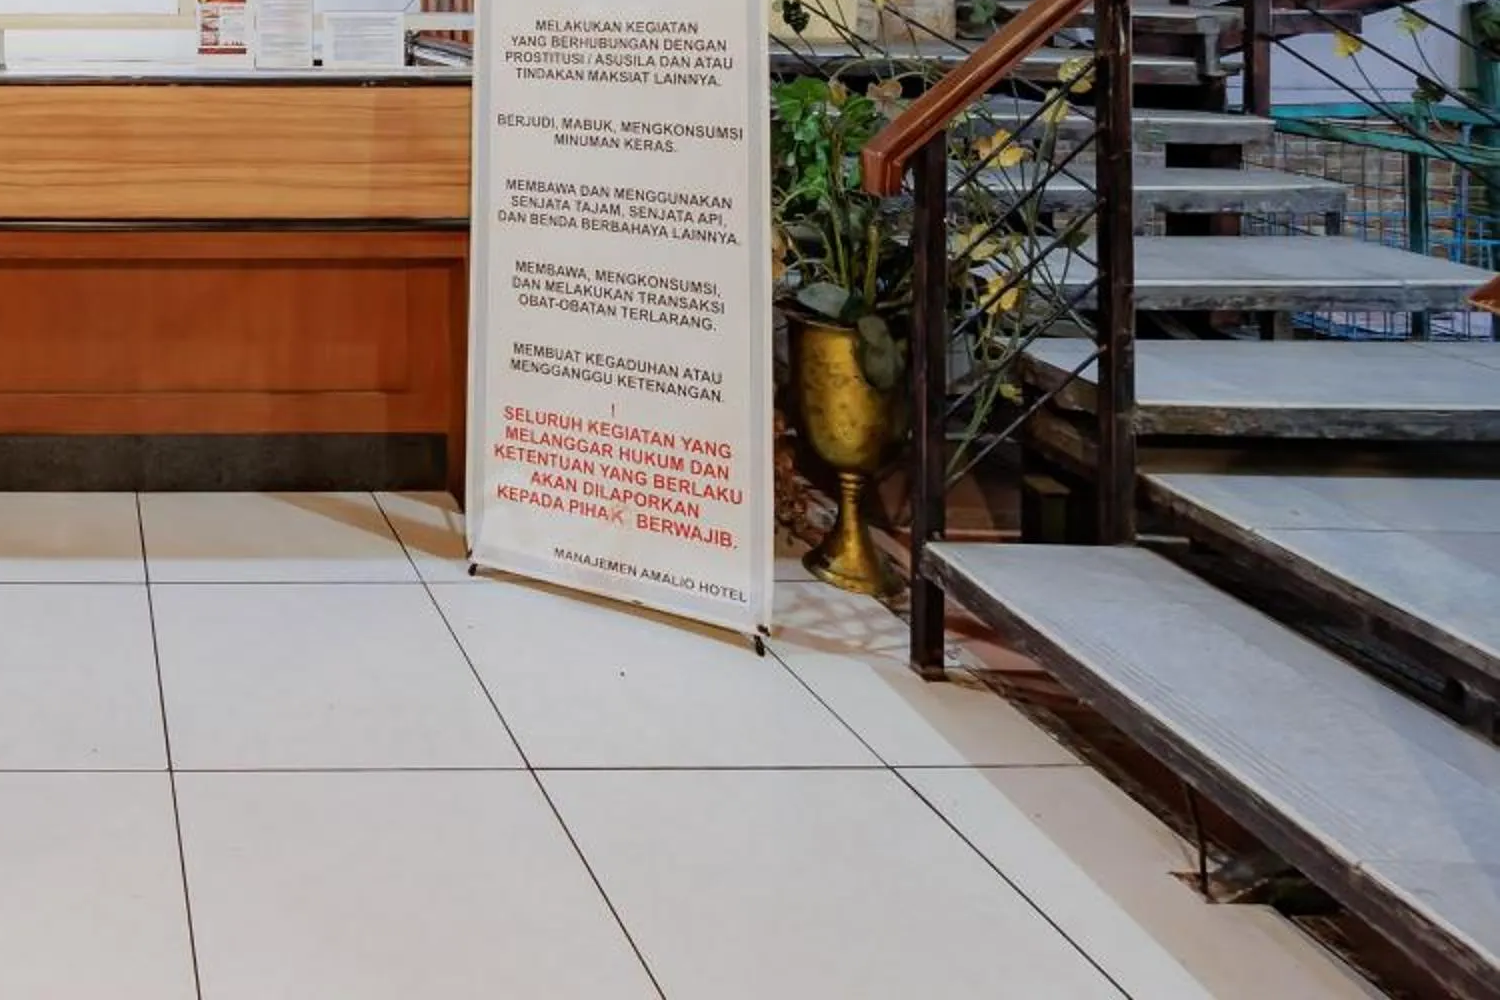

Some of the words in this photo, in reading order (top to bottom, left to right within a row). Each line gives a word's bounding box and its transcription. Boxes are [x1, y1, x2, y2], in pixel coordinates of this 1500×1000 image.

[535, 19, 623, 34] MELAKUKAN
[625, 21, 699, 35] KEGIATAN
[511, 35, 547, 49] YANG
[551, 36, 659, 52] BERHUBUNGAN
[663, 39, 727, 53] DENGAN
[505, 50, 585, 66] PROSTITUSI
[594, 53, 657, 69] ASUSILA
[659, 55, 691, 70] DAN
[693, 56, 734, 71] ATAU
[515, 67, 585, 81] TINDAKAN
[587, 69, 651, 84] MAKSIAT
[554, 134, 620, 148] MINUMAN
[620, 121, 743, 140] MENGKONSUMSI
[506, 179, 577, 196] MEMBAWA
[580, 184, 610, 198] DAN
[614, 188, 732, 209] MENGGUNAKAN
[498, 210, 528, 224] DAN
[530, 213, 579, 229] BENDA
[582, 218, 669, 238] BERBAHAYA
[510, 196, 571, 211] SENJATA
[629, 206, 694, 224] SENJATA
[512, 276, 541, 291] DAN
[543, 280, 634, 302] MELAKUKAN
[636, 291, 724, 314] TRANSAKSI
[518, 293, 617, 316] OBAT-OBATAN
[510, 358, 613, 385] MENGGANGGU
[513, 342, 582, 363] MEMBUAT
[585, 352, 680, 378] KEGADUHAN
[682, 368, 722, 385] ATAU
[504, 406, 583, 432] SELURUH
[587, 420, 676, 447] KEGIATAN
[680, 436, 732, 458] YANG
[506, 426, 614, 458] MELANGGAR
[618, 446, 684, 470] HUKUM
[690, 460, 729, 480] DAN
[494, 444, 595, 474] KETENTUAN
[599, 464, 648, 486] YANG
[653, 474, 743, 505] BERLAKU
[498, 484, 564, 510] KEPADA
[567, 499, 624, 523] PIHAK
[531, 471, 578, 492] AKAN
[583, 481, 700, 518] DILAPORKAN
[554, 548, 637, 576] MANAJEMEN
[640, 568, 696, 590] AMALIO
[698, 580, 747, 603] HOTEL
